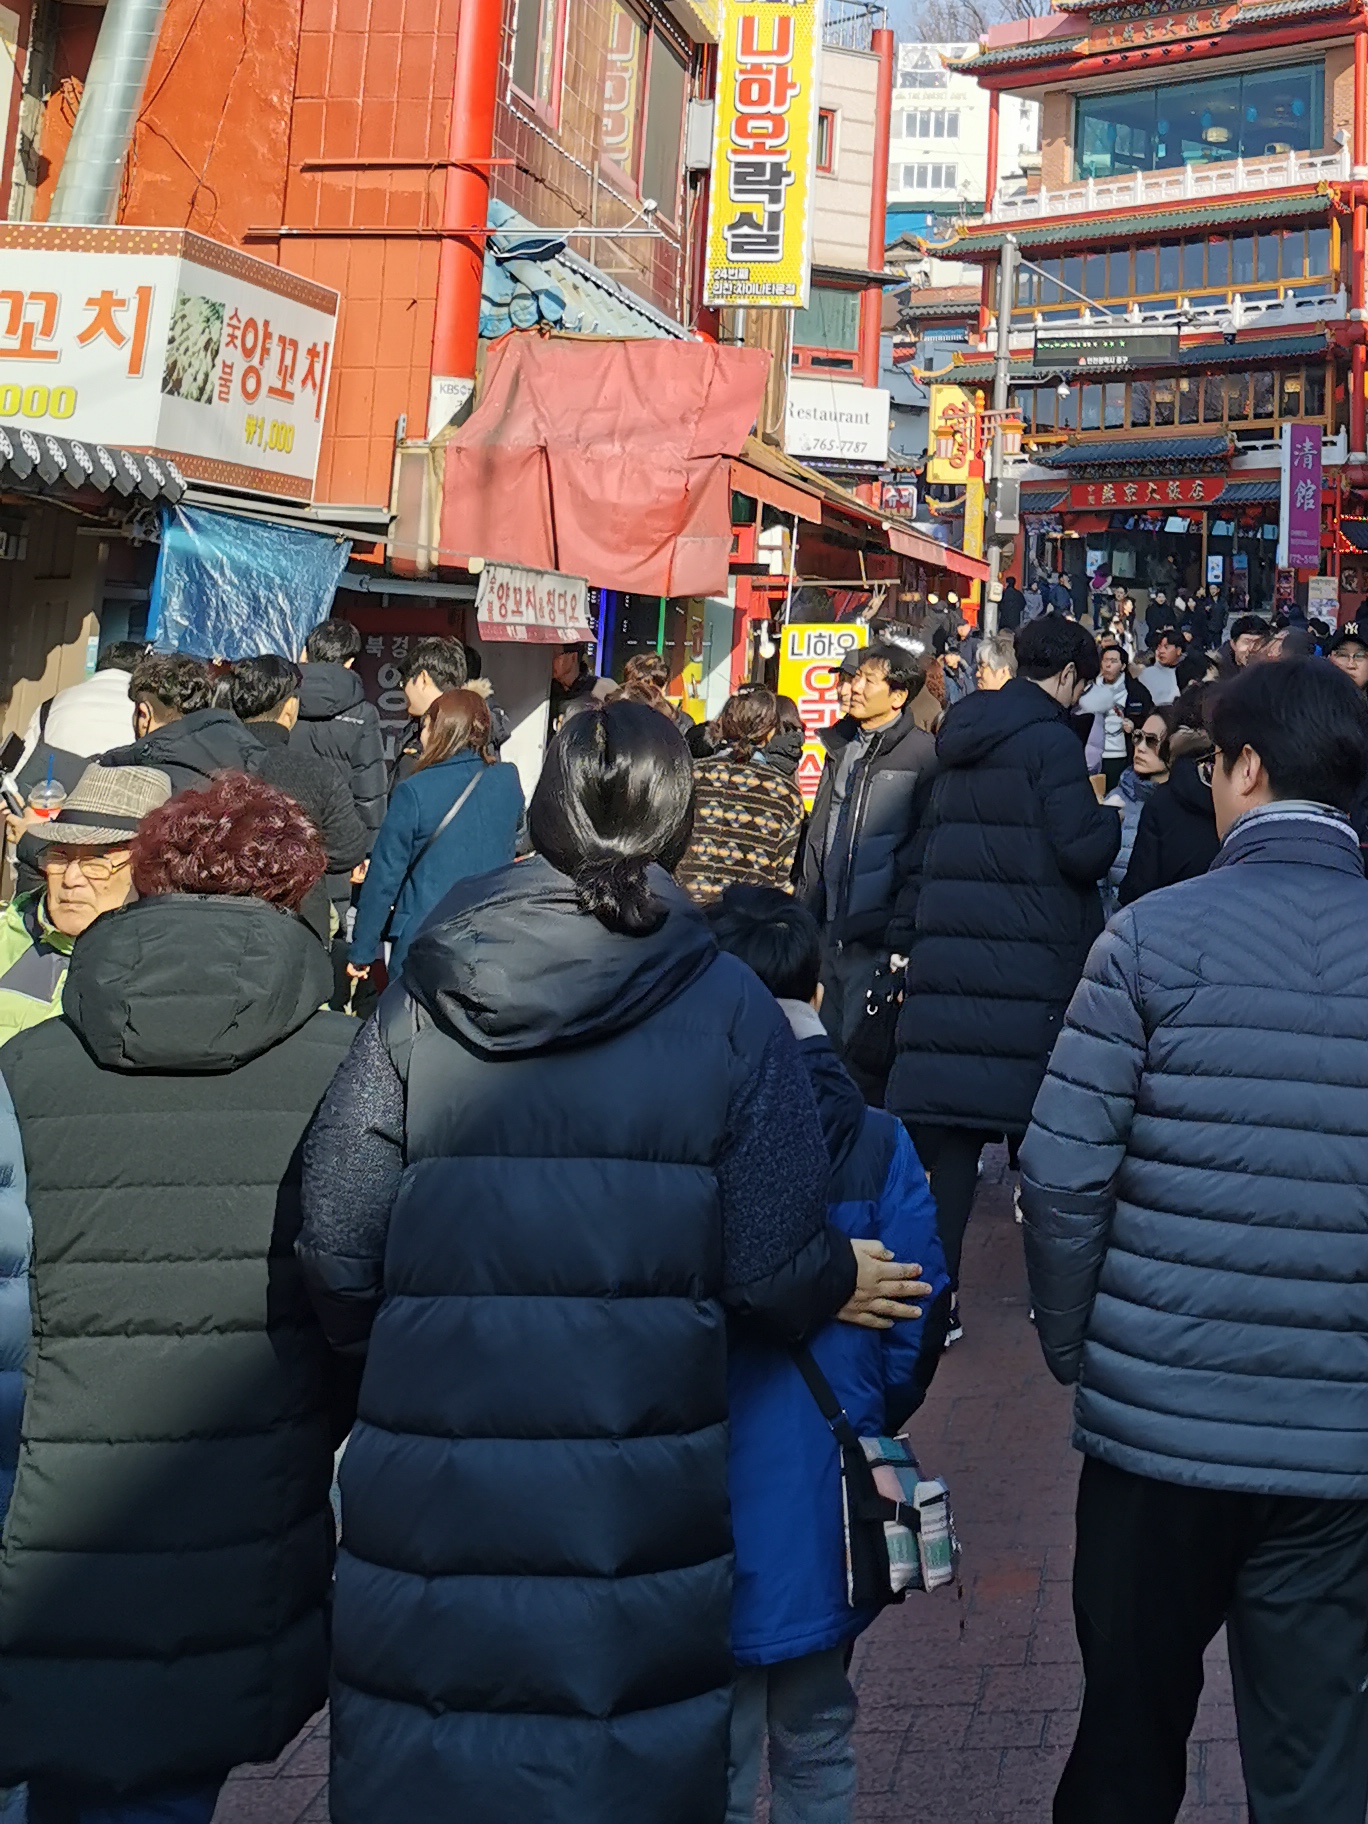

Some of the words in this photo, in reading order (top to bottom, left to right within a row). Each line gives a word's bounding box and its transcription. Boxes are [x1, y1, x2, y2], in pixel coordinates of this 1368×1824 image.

[240, 316, 331, 421] 양꼬치
[813, 437, 867, 453] 765-7787
[790, 632, 856, 657] 니하오
